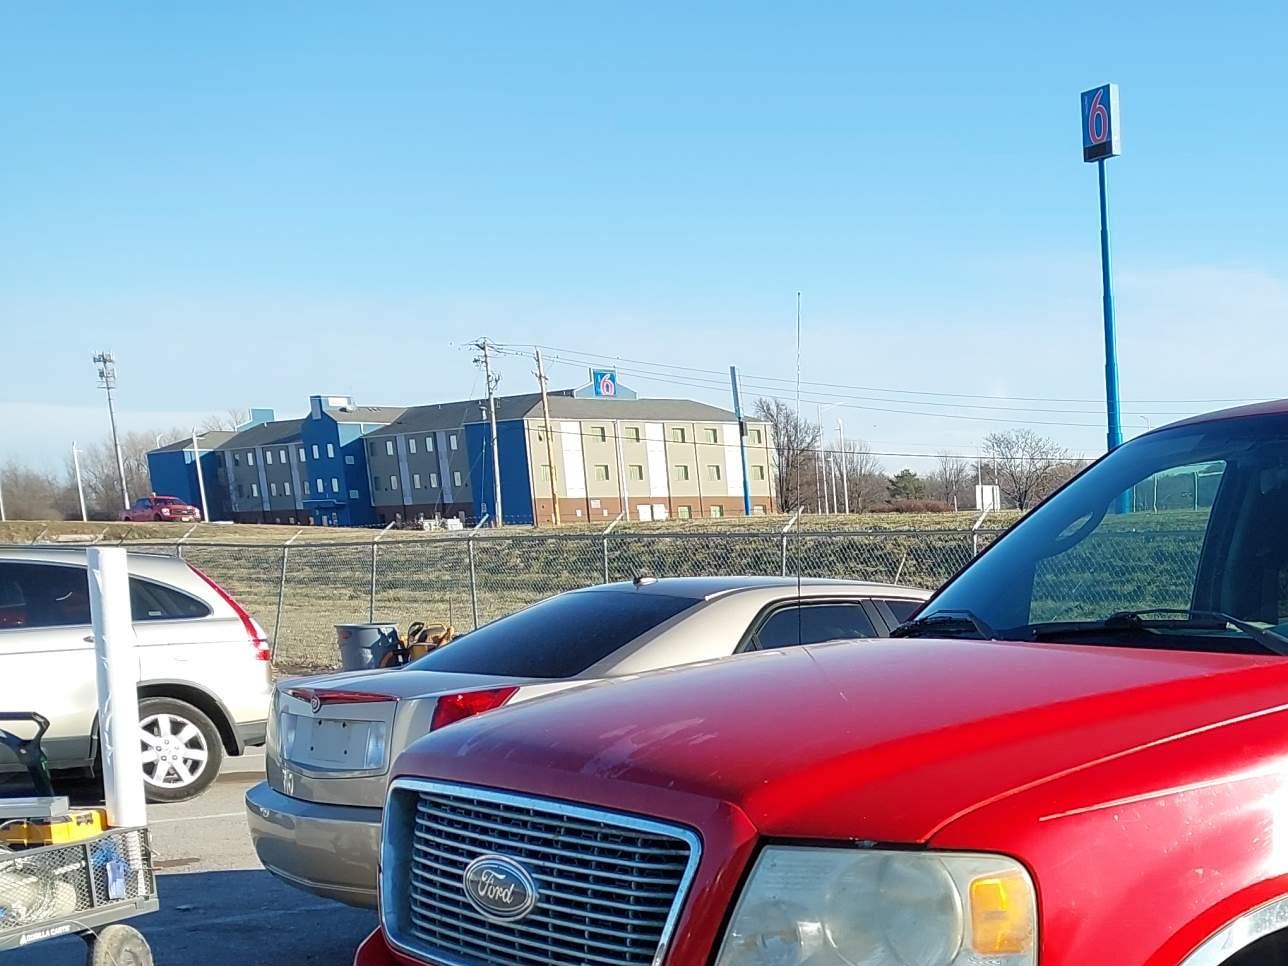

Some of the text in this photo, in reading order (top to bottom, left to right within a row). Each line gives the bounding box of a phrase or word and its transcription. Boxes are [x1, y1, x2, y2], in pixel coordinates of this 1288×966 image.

[1088, 88, 1109, 145] 6
[600, 373, 615, 397] 6
[477, 869, 516, 904] Ford
